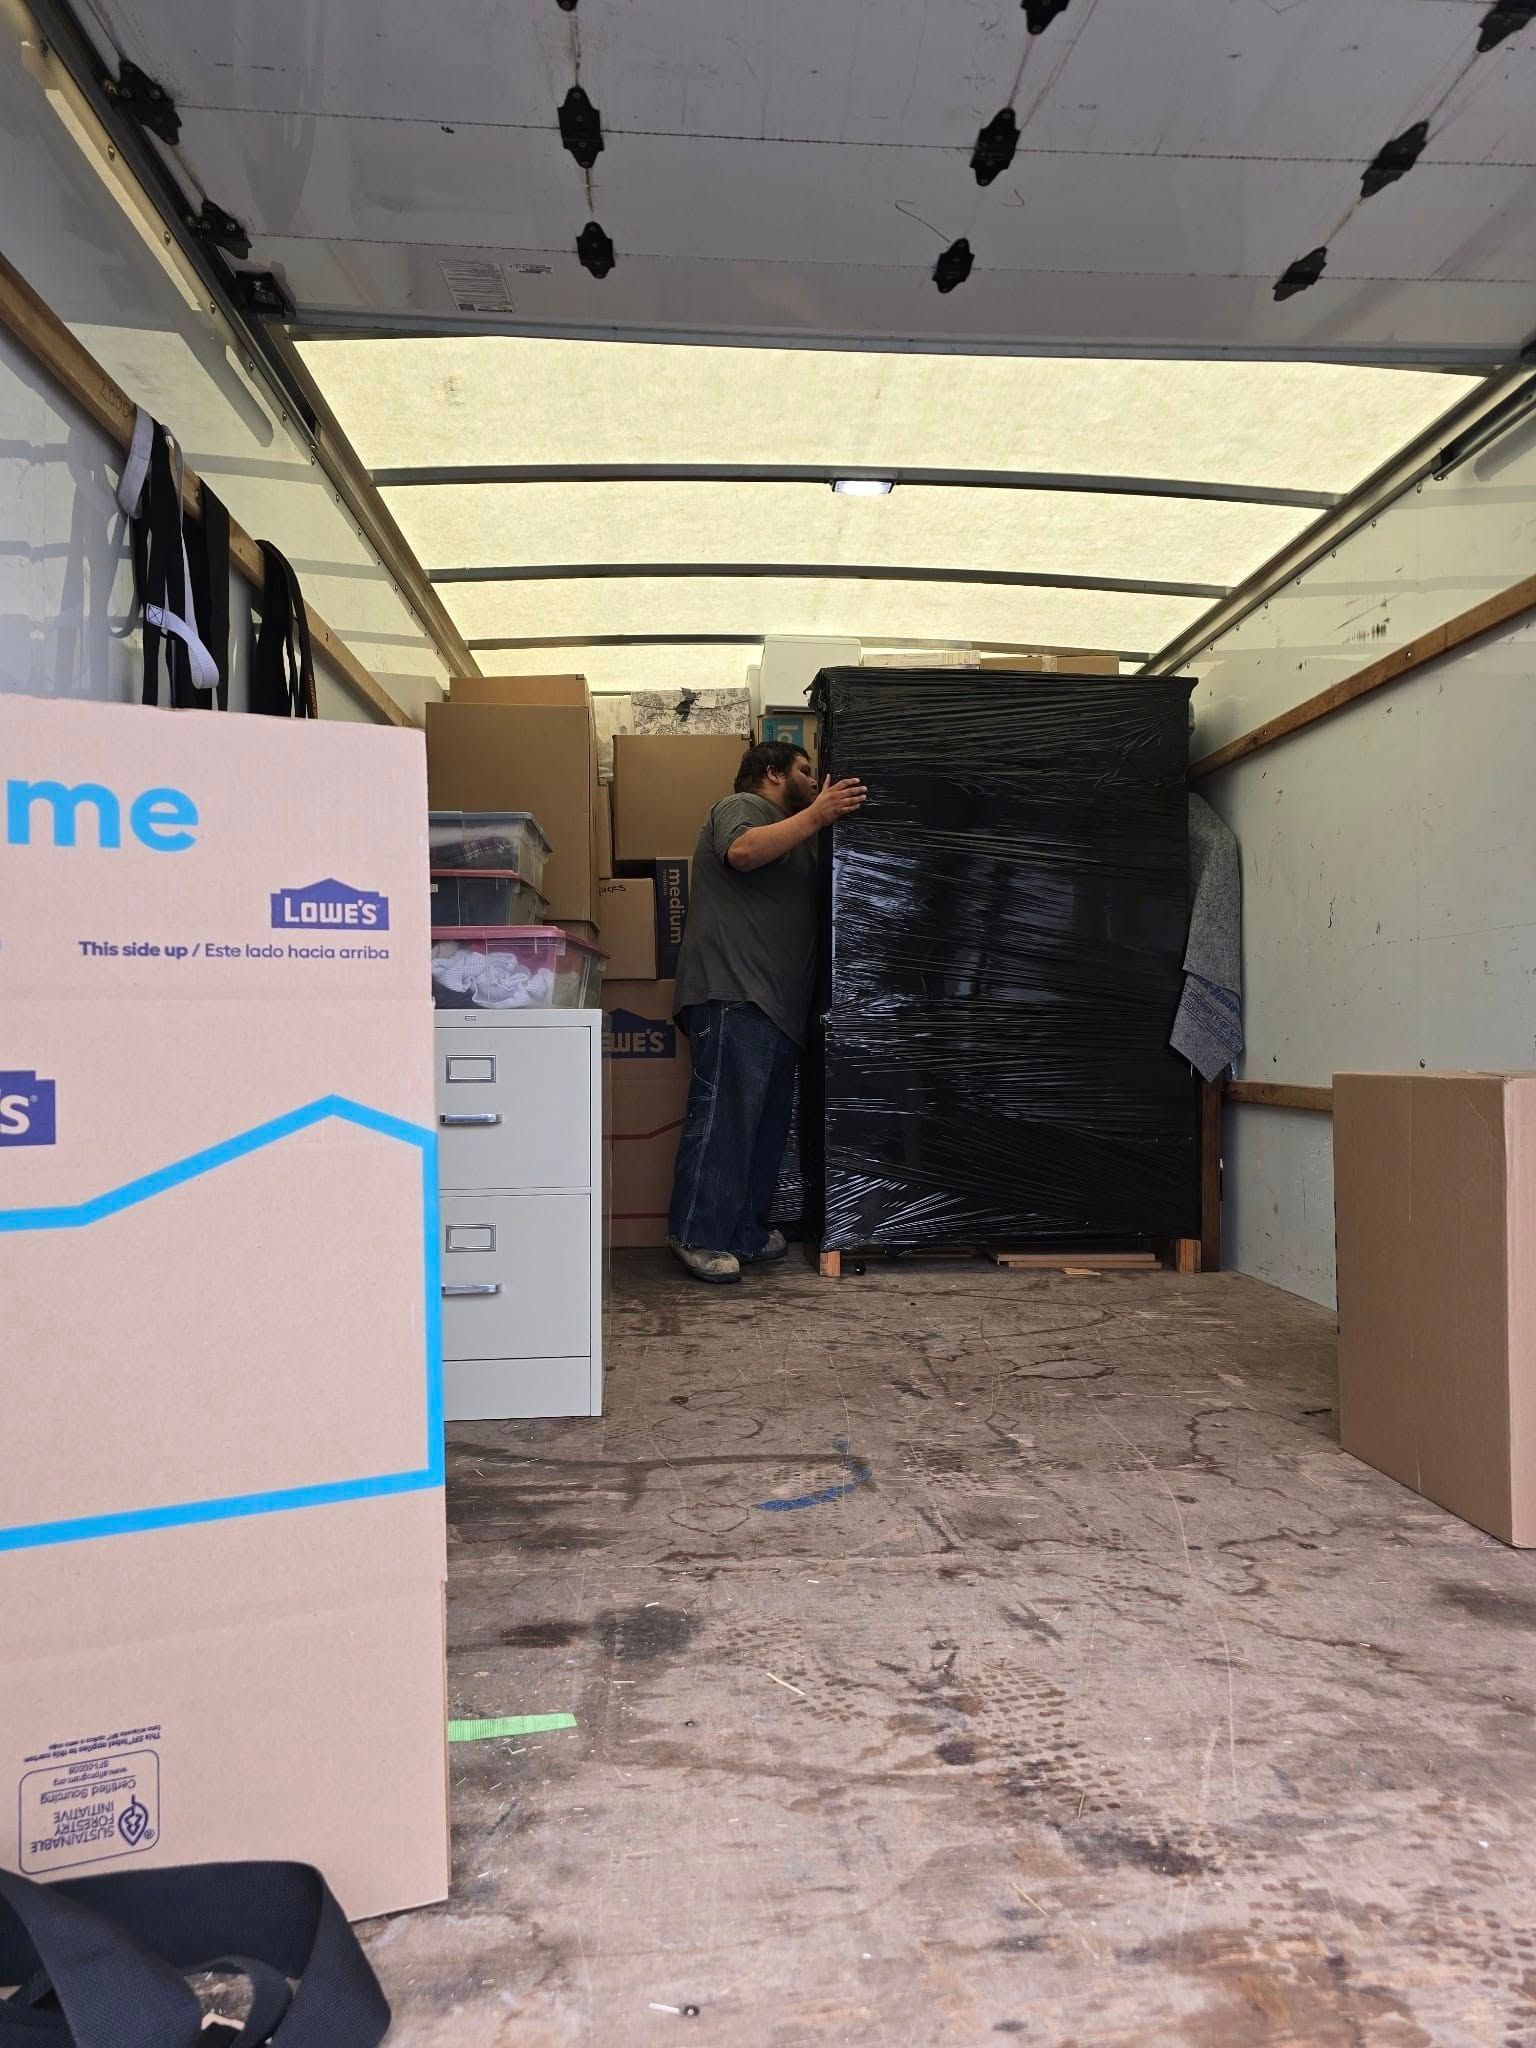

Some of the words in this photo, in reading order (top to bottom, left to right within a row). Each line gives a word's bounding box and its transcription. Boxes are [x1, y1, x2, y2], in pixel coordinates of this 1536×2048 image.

[7, 778, 199, 853] me
[284, 896, 378, 925] LOWE'S
[668, 868, 686, 944] medium
[78, 940, 119, 957] This
[122, 941, 161, 957] side
[164, 945, 189, 960] up
[205, 943, 241, 958] Este
[245, 944, 284, 959] lado
[288, 944, 335, 959] hacia
[339, 945, 389, 960] arriba
[40, 1787, 88, 1805] Sourcing
[91, 1778, 136, 1796] Certified
[53, 1799, 115, 1824] INITIATIVE
[54, 1812, 115, 1837] FORESTRY
[31, 1825, 115, 1853] SUSTAINABLE
